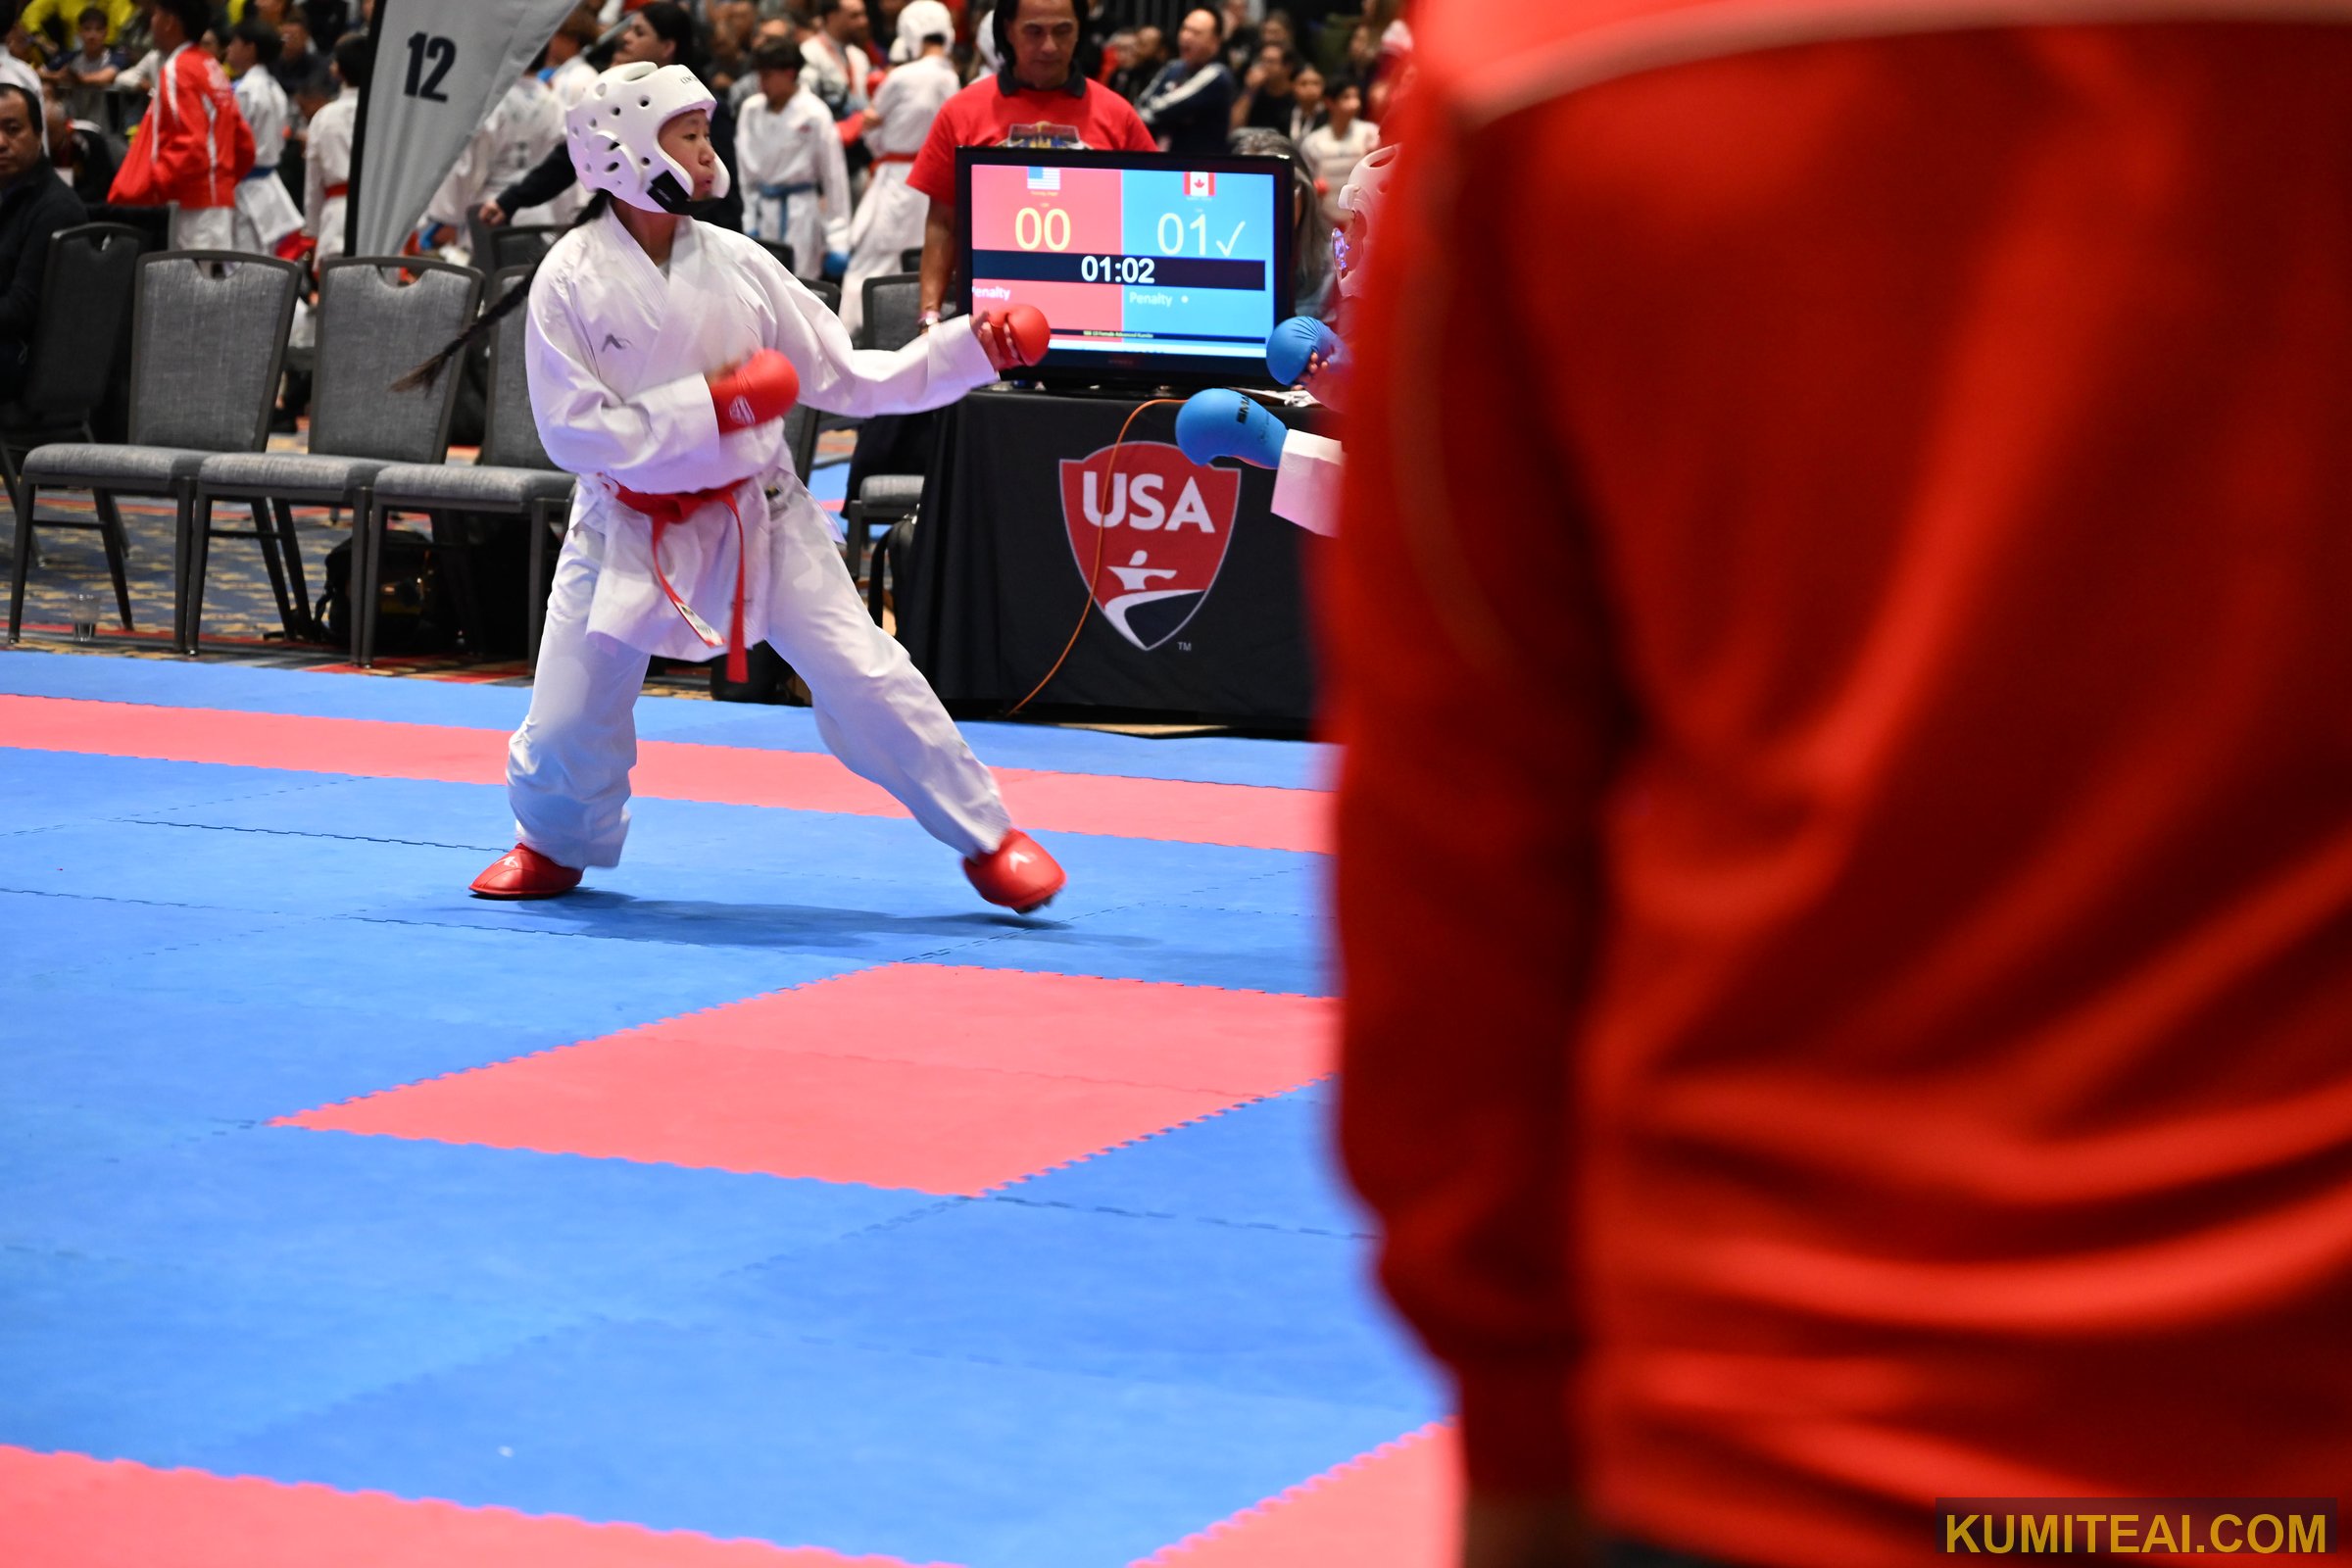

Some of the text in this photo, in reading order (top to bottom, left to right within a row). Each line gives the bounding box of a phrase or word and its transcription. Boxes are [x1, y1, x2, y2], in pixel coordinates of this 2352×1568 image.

[404, 30, 457, 104] 12
[1014, 207, 1071, 252] 00
[1156, 212, 1206, 256] 01
[1081, 255, 1155, 284] 01:02
[1129, 291, 1173, 308] Penalty
[1082, 470, 1216, 533] USA
[1178, 641, 1192, 652] TM
